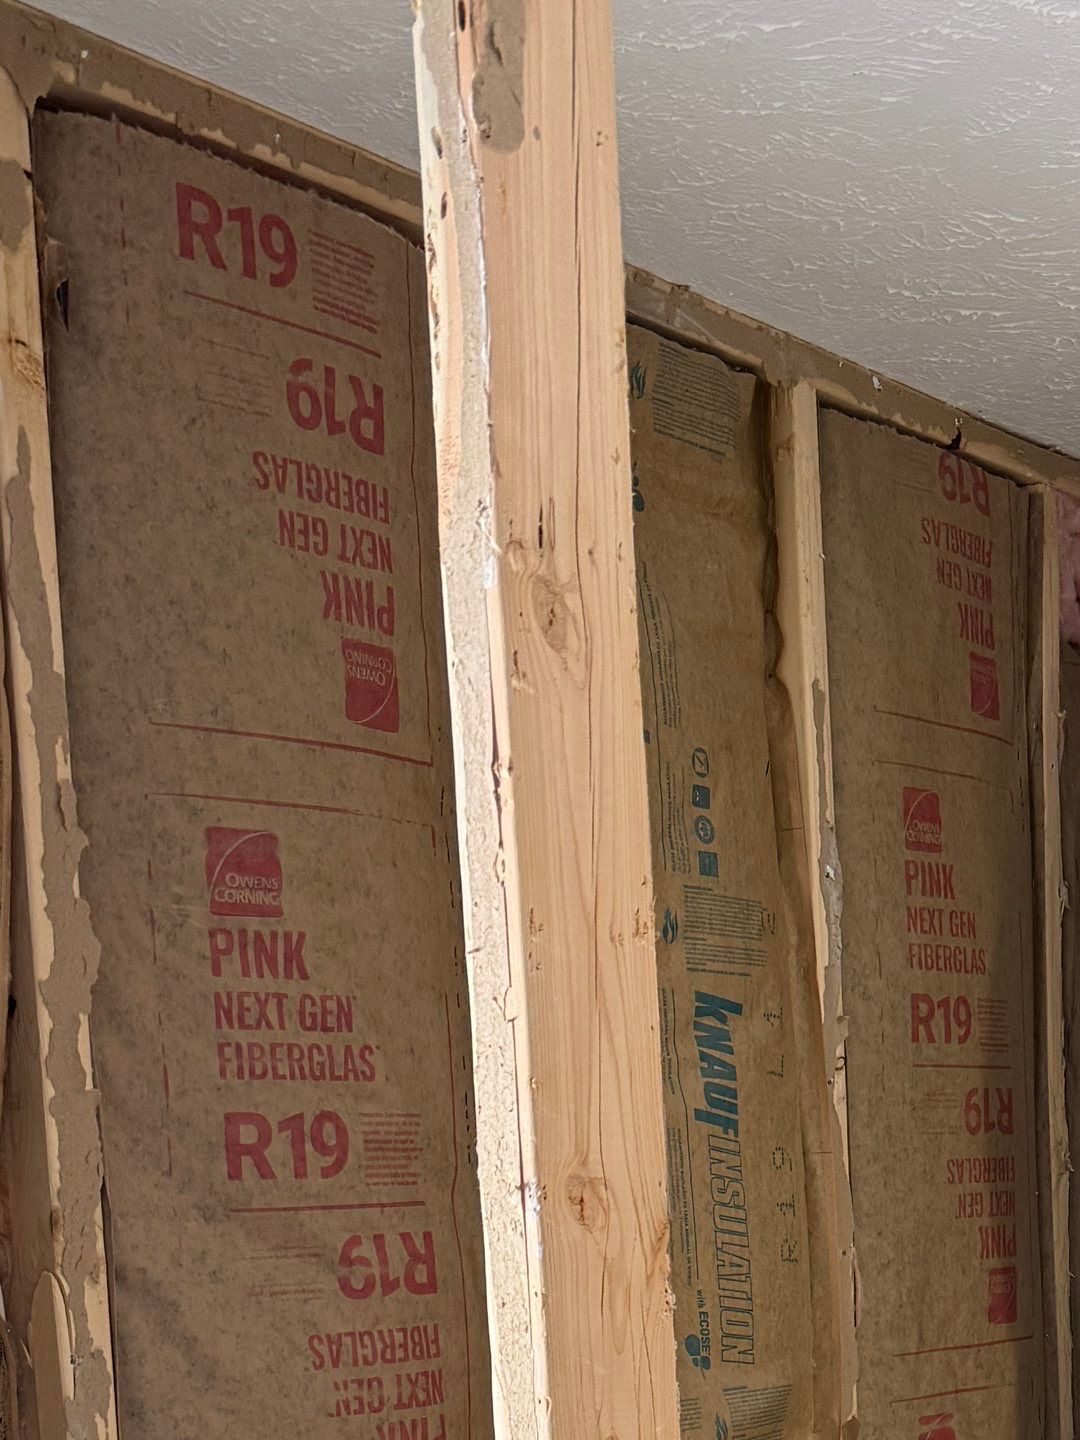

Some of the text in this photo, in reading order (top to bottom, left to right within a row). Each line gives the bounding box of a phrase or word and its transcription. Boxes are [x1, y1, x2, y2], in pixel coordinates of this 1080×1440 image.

[175, 182, 298, 288] R19
[286, 358, 385, 456] R19
[252, 451, 389, 525] FIBERGLAS
[938, 451, 991, 518] R19
[277, 510, 393, 574] NEXT GEN
[921, 517, 992, 568] FIBERGLAS
[322, 572, 395, 636] PINK
[936, 557, 992, 604] NEXT GEN
[958, 602, 995, 650] PINK
[214, 888, 280, 905] CORNING
[225, 872, 279, 890] OWENS
[904, 859, 954, 900] PINK
[906, 906, 976, 939] NEXT GEN
[207, 928, 309, 981] PINK
[908, 949, 986, 976] FIBERGLAS
[213, 992, 354, 1033] NEXT GEN
[911, 993, 972, 1045] R19
[218, 1042, 377, 1083] FIBERGLAS
[693, 991, 744, 1138] KNAUF
[964, 1087, 1014, 1136] R19
[224, 1110, 349, 1181] R19
[946, 1156, 1016, 1184] FIBERGLAS
[958, 1191, 1015, 1218] NEXT GEN
[338, 1231, 438, 1300] R19
[708, 1134, 755, 1365] INSULATION
[979, 1225, 1016, 1259] PINK
[308, 1322, 440, 1371] FIBERGLAS
[696, 1288, 712, 1356] with ECOSE
[333, 1369, 443, 1417] NEXT GEN
